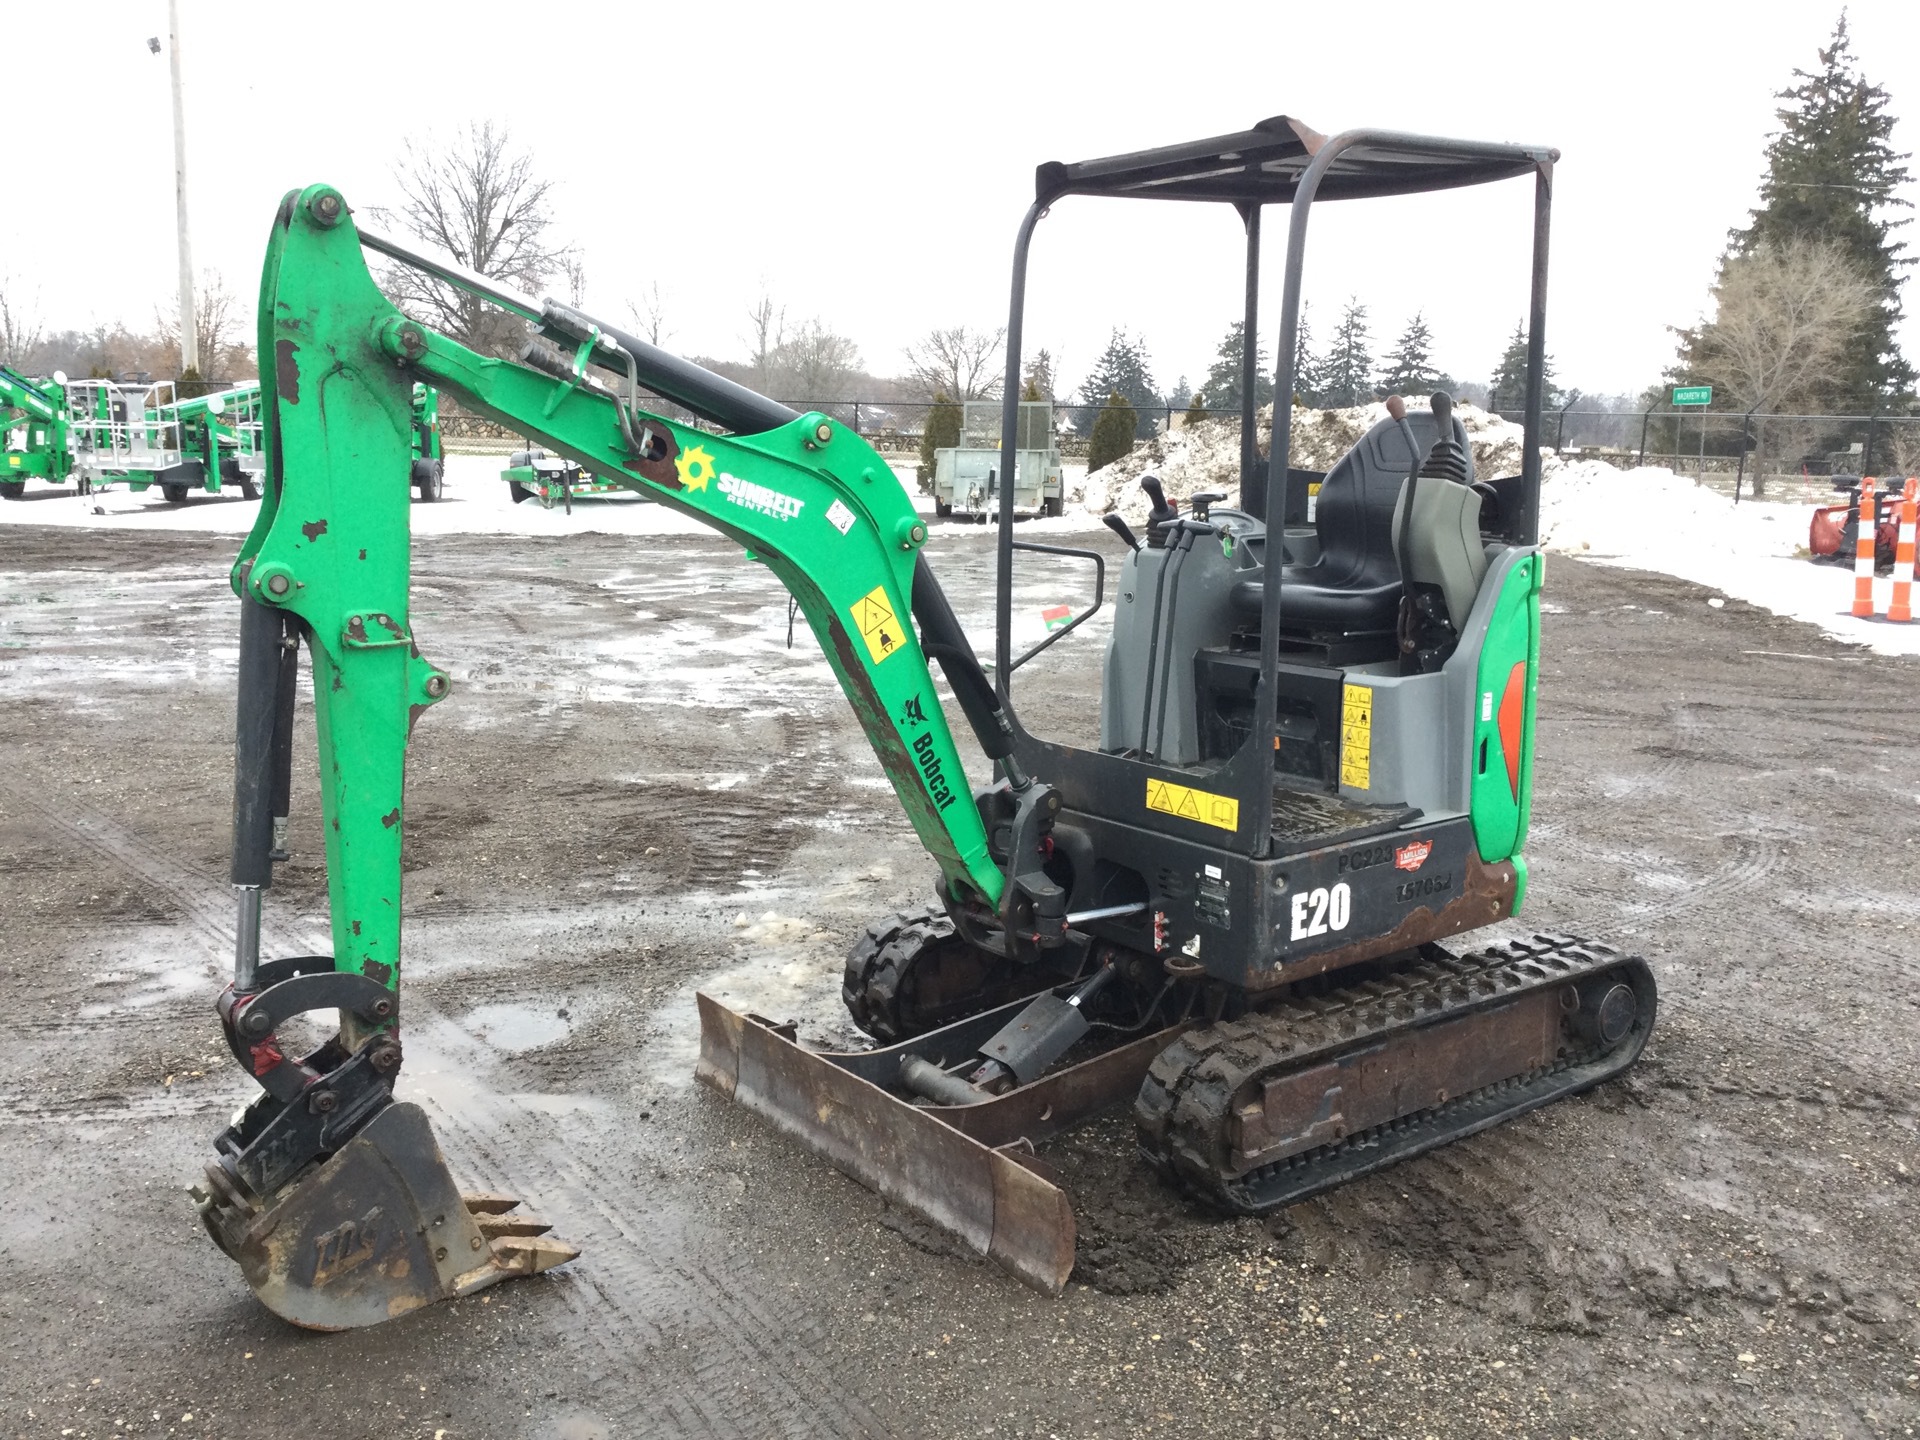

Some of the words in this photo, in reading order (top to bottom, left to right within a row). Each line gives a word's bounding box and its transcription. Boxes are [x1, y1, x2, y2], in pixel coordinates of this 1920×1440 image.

[717, 472, 805, 519] SUNBELT
[726, 494, 789, 522] RENTALS
[912, 731, 957, 812] Bobcat
[1290, 882, 1351, 942] E20
